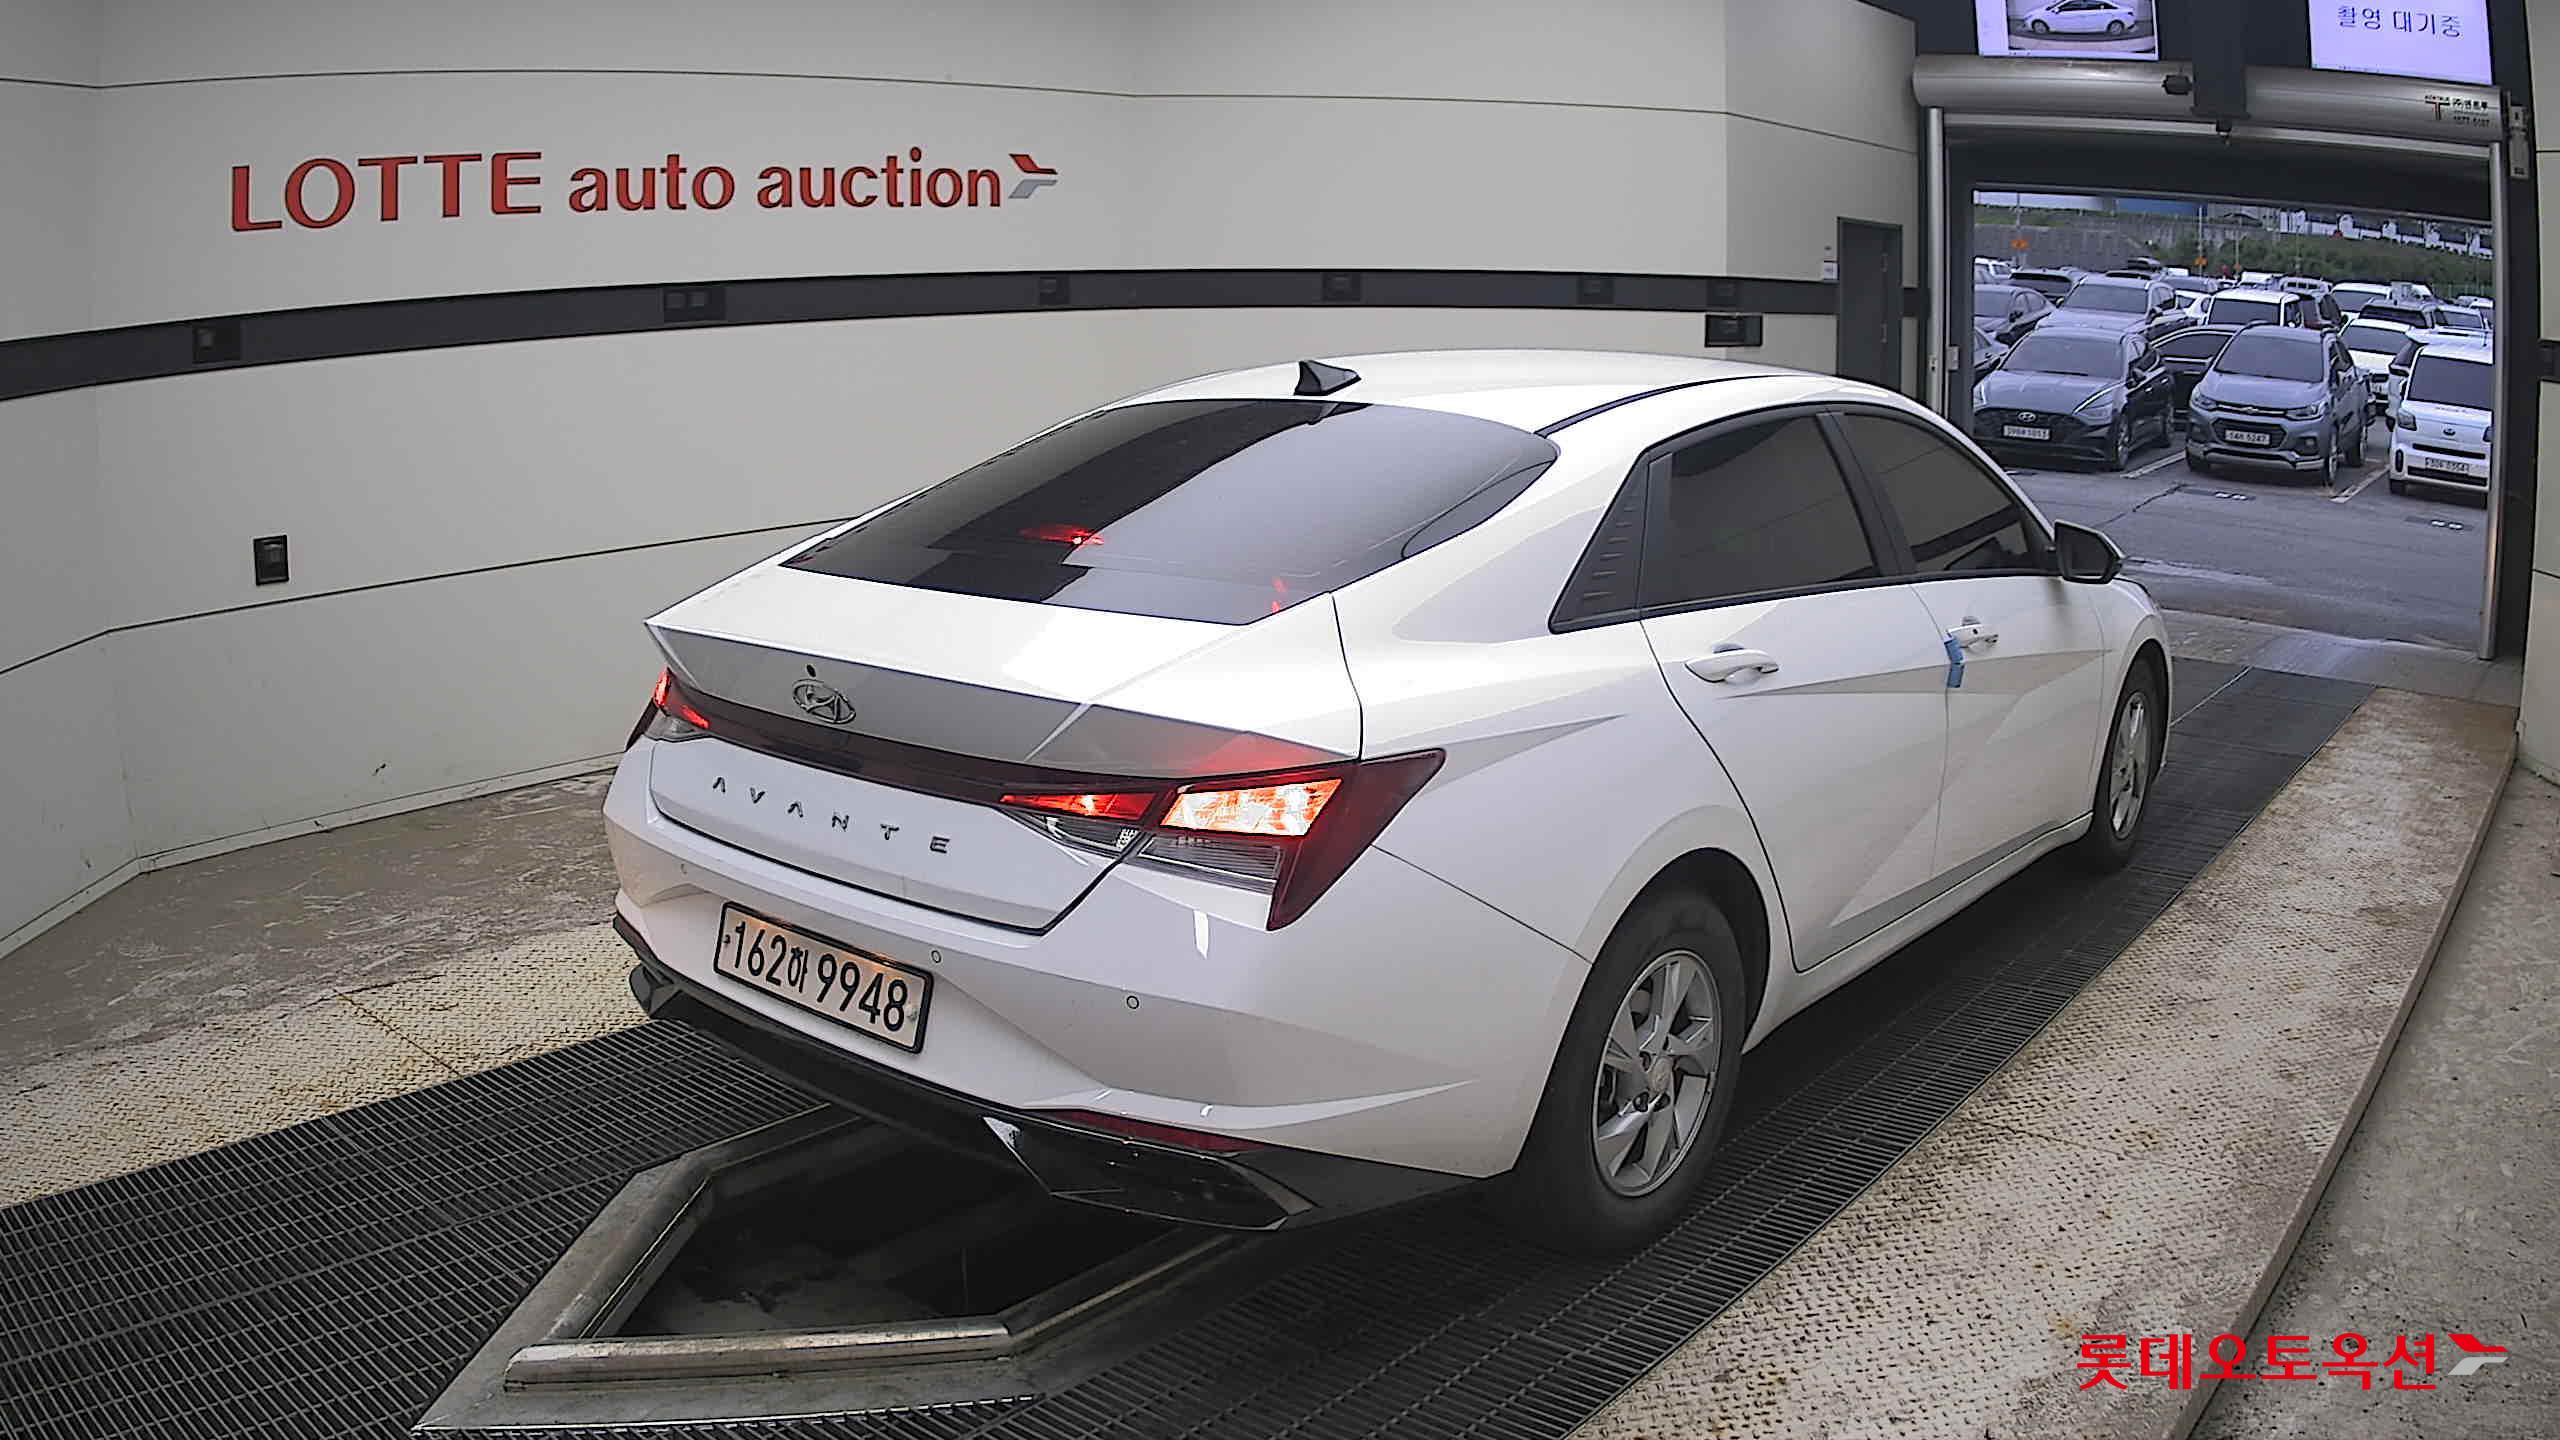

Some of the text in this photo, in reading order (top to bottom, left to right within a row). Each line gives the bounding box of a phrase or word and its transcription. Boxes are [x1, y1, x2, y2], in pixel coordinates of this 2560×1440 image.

[2338, 6, 2461, 38] 촬영 대기중
[231, 146, 1003, 233] LOTTE auto auction
[711, 775, 952, 855] AVANTE
[816, 953, 909, 1033] 9948
